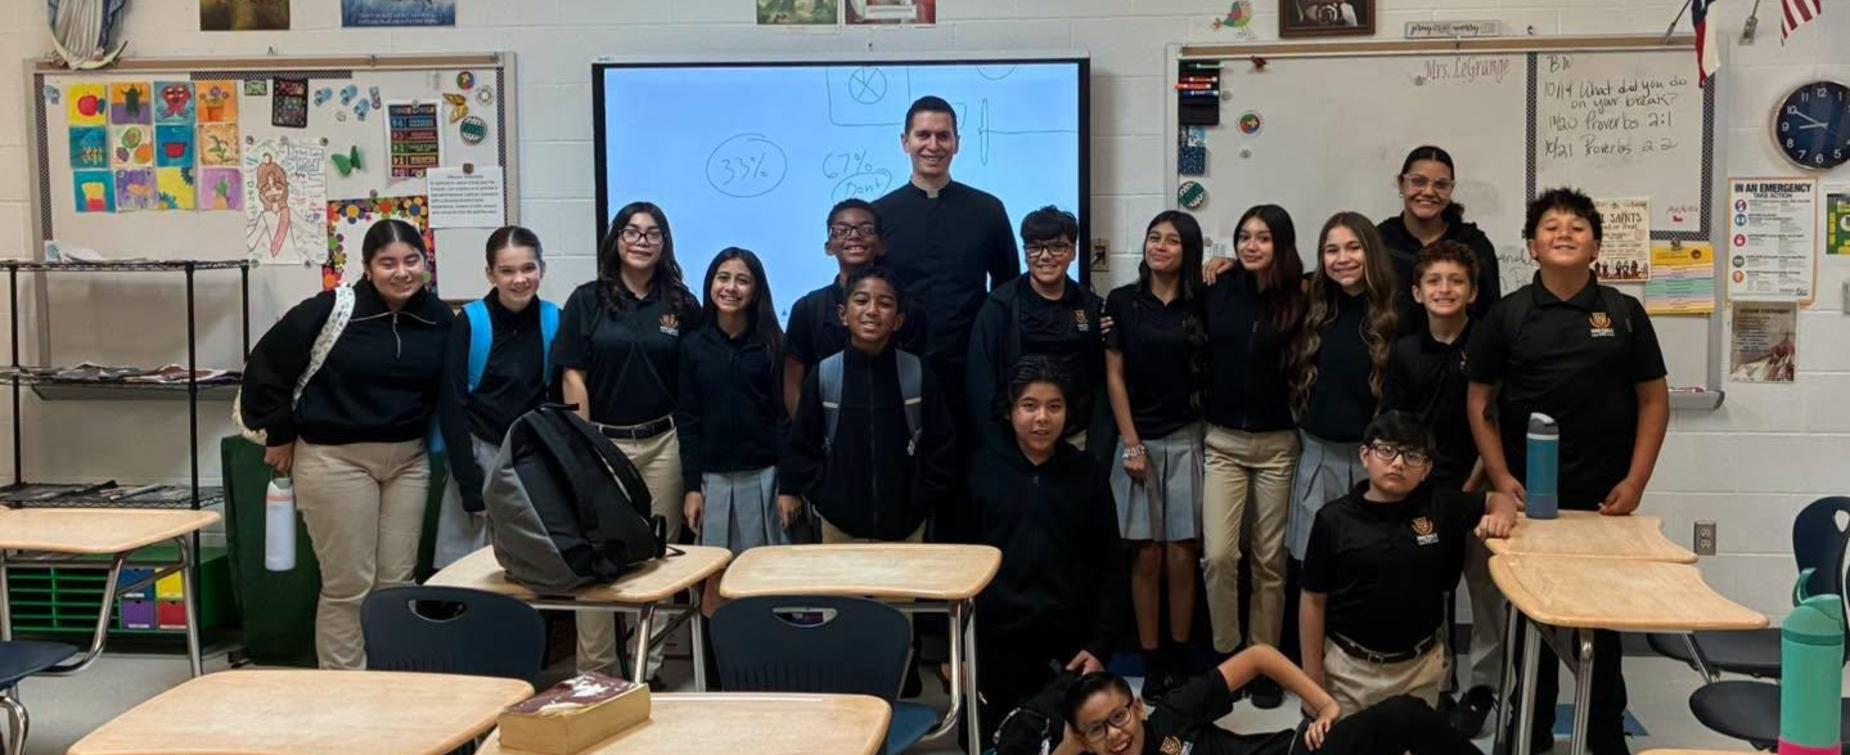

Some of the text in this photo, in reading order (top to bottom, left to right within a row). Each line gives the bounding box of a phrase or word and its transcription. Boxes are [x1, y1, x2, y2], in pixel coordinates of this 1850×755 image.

[1579, 79, 1611, 99] What
[1618, 79, 1638, 94] did
[1641, 81, 1664, 99] you
[1669, 75, 1687, 87] do
[1817, 87, 1827, 98] 12
[1801, 92, 1809, 102] 11
[1571, 100, 1586, 110] on
[1786, 105, 1797, 115] 10
[1584, 109, 1640, 130] Proverbs
[1648, 111, 1672, 128] 2:1
[1781, 121, 1789, 132] 9
[1580, 135, 1633, 158] Proverbs
[1786, 138, 1794, 149] 8
[1798, 149, 1807, 159] 7
[1815, 153, 1824, 164] 6
[1833, 148, 1841, 159] 5
[722, 151, 768, 186] 33%
[822, 150, 873, 179] 67%
[1734, 182, 1811, 193] IN AN EMERGENCY
[1610, 212, 1642, 224] SAINTS
